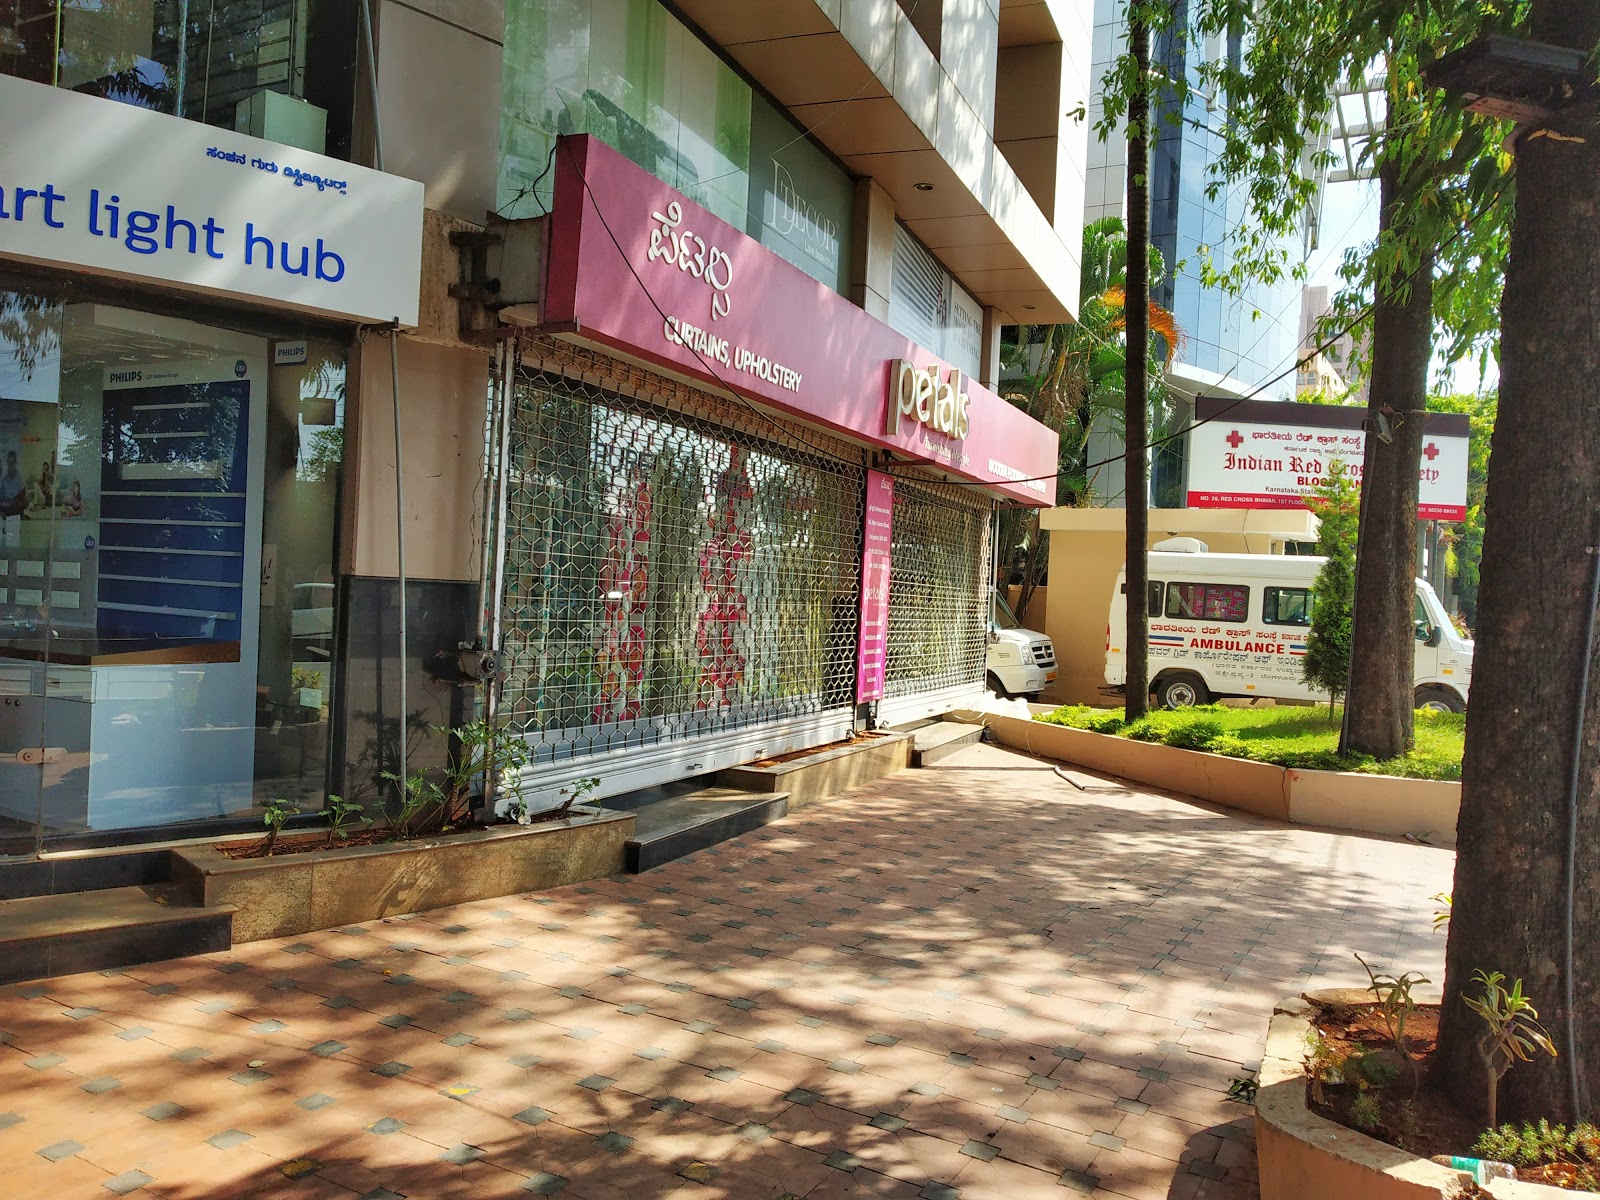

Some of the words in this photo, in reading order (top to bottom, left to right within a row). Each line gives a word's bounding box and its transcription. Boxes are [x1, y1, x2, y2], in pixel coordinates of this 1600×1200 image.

[88, 189, 225, 259] light
[244, 222, 346, 283] hub
[277, 347, 305, 356] PHILIPS
[663, 315, 731, 368] CURTAINS,
[734, 346, 803, 393] UPHOLSTERY
[109, 371, 142, 383] PHILIPS
[887, 358, 970, 441] petals
[1223, 452, 1283, 472] Indian
[1288, 455, 1322, 474] Red
[1265, 486, 1299, 494] Karnataka
[1190, 638, 1285, 655] AMBULANCE
